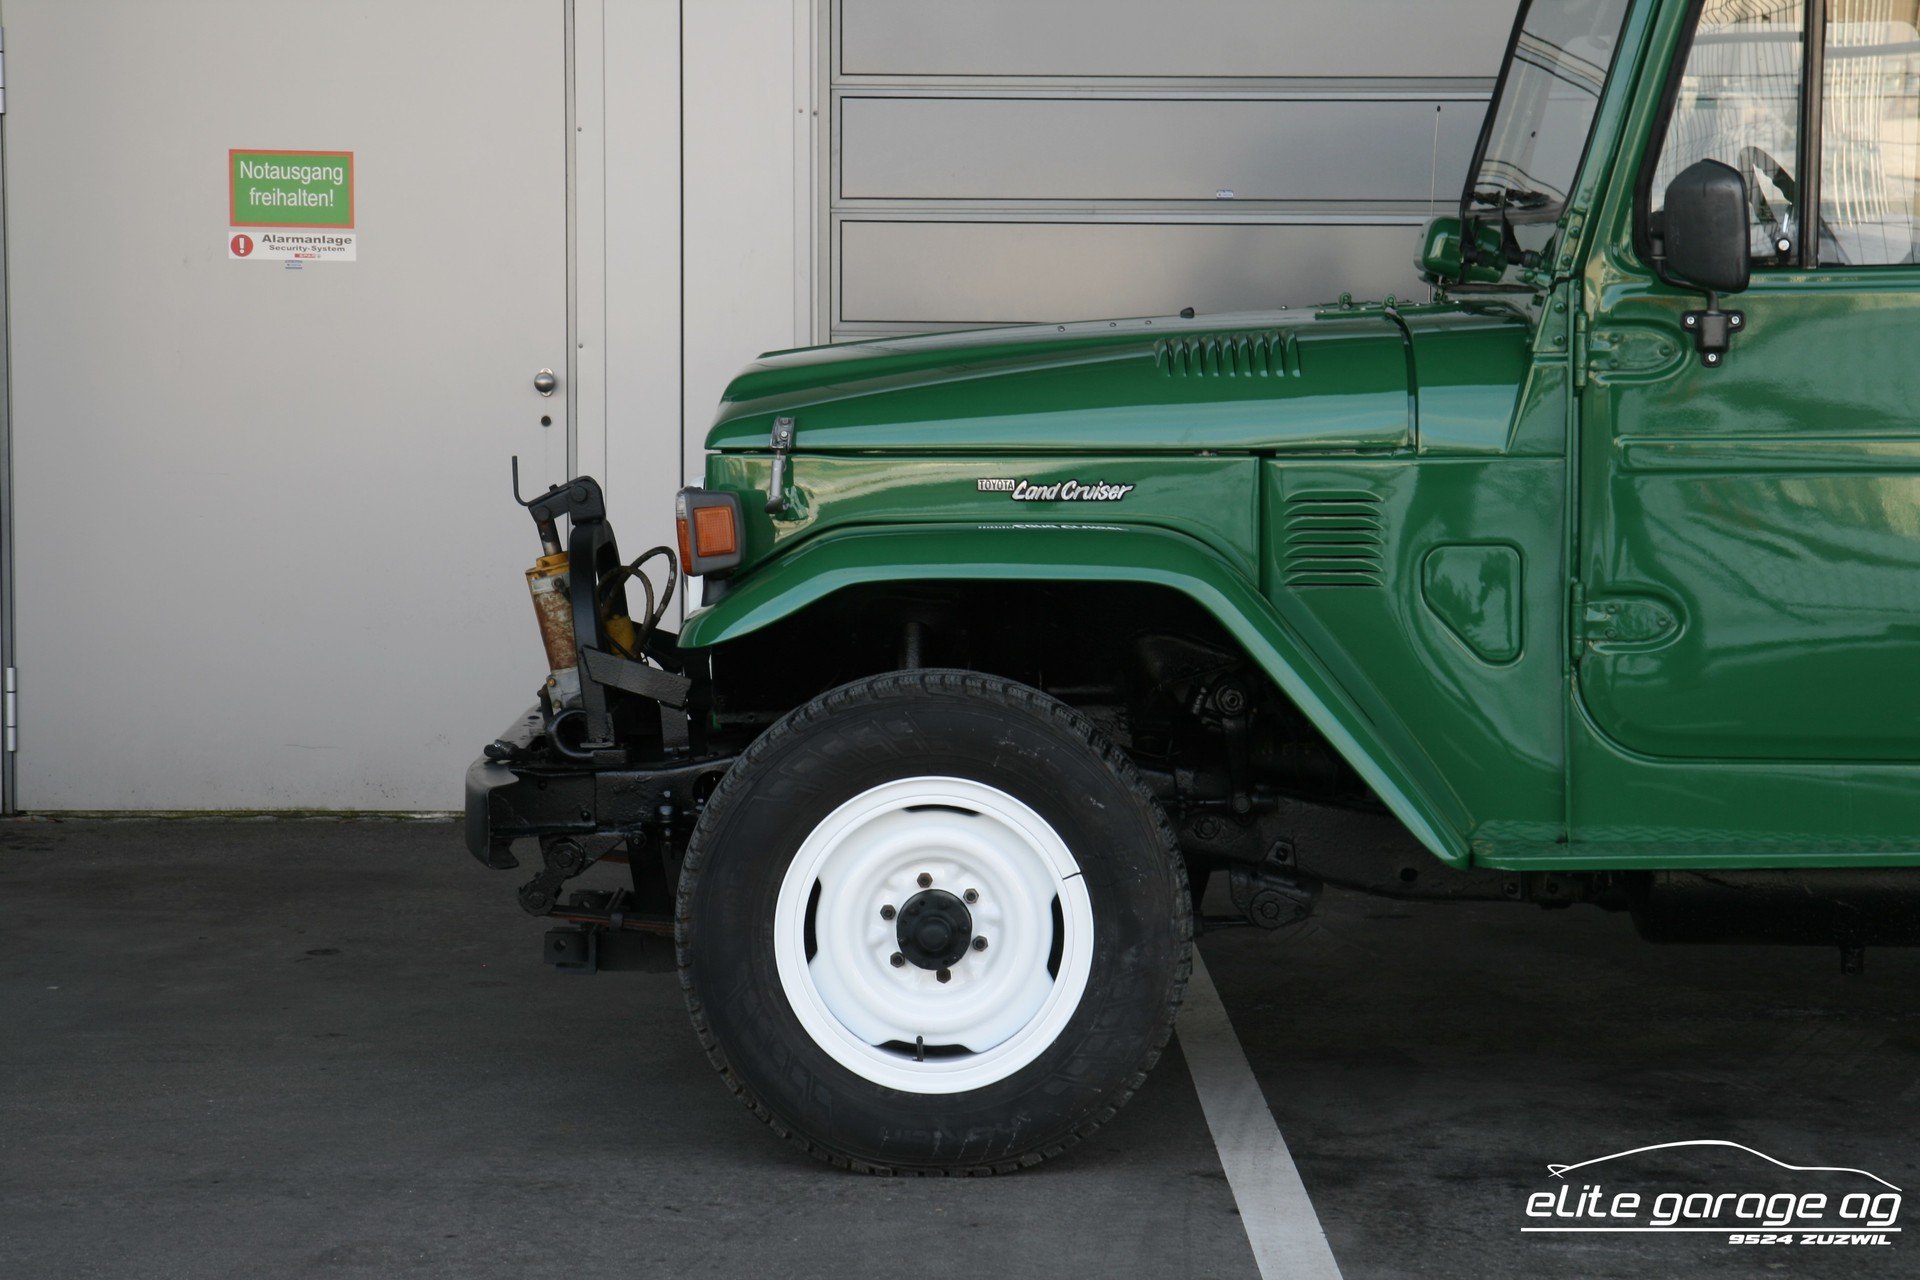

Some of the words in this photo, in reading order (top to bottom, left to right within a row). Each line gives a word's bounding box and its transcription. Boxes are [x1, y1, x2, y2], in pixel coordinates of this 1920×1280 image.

[240, 160, 343, 185] Notausgang
[249, 187, 334, 207] freihalten!
[262, 234, 353, 246] Alarmanlage
[268, 244, 346, 253] Security-System
[978, 479, 1015, 490] TOYOTA
[1012, 480, 1061, 500] Land
[1061, 480, 1134, 501] Cruiser
